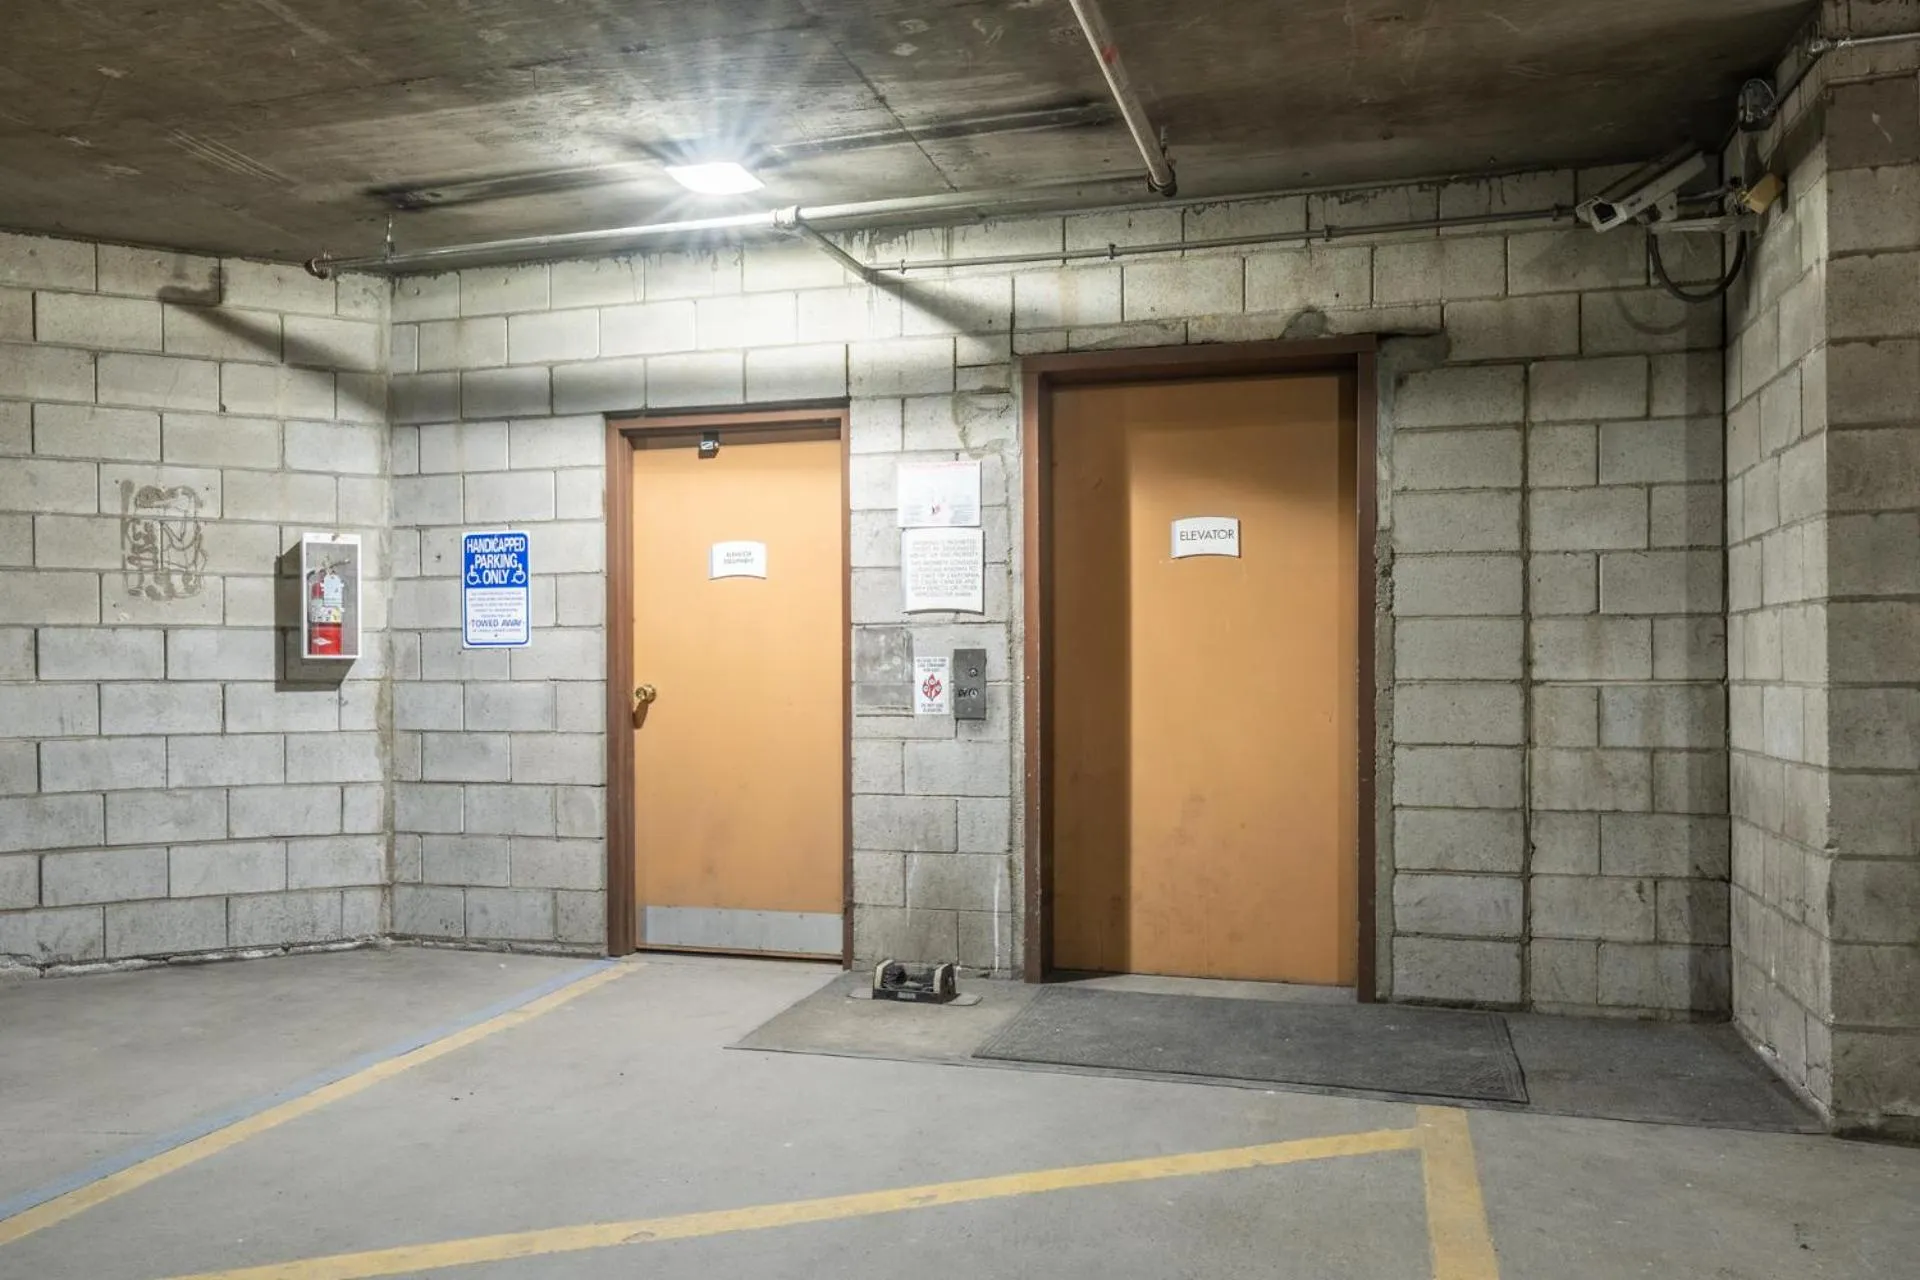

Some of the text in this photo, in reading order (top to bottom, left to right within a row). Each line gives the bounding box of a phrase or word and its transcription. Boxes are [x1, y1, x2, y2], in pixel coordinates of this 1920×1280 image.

[1180, 529, 1235, 541] ELEVATOR
[466, 537, 526, 553] HANDICAPPED
[475, 553, 518, 569] PARKING
[482, 569, 510, 584] ONLY
